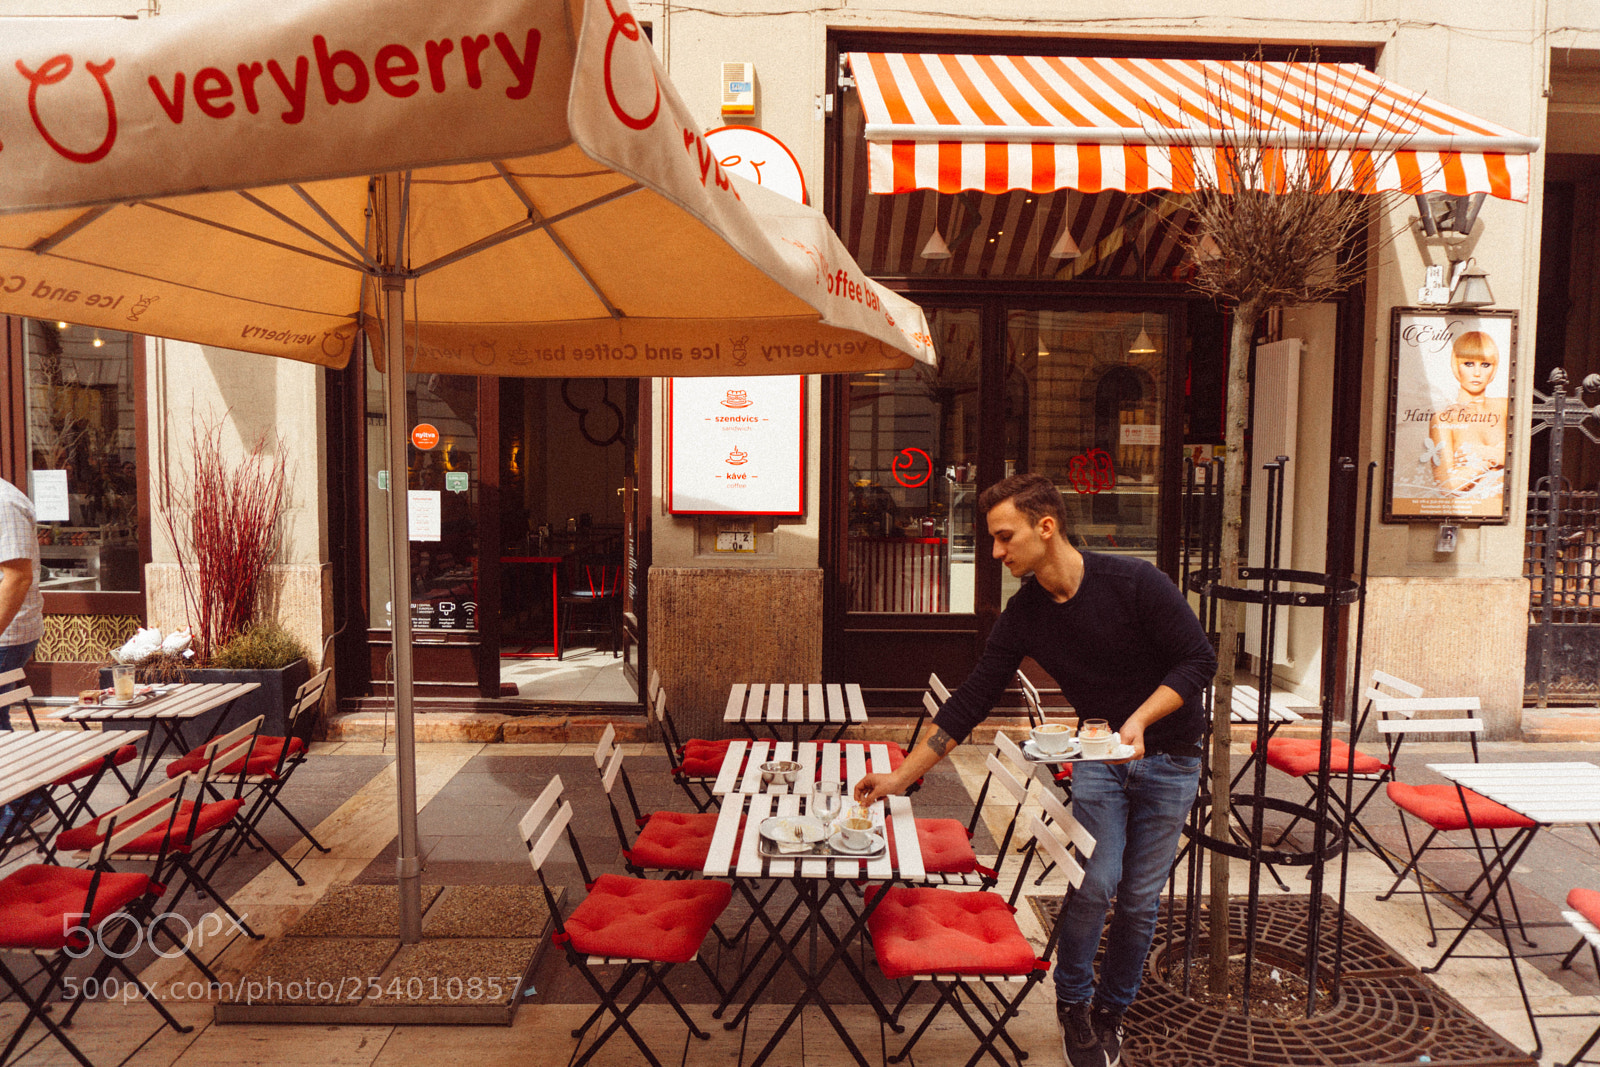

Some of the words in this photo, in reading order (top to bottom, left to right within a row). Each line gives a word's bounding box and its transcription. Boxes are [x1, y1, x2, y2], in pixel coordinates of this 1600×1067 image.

[148, 28, 542, 124] veryberry
[827, 269, 863, 303] offee
[1403, 408, 1436, 422] Hair
[1457, 408, 1501, 427] beauty
